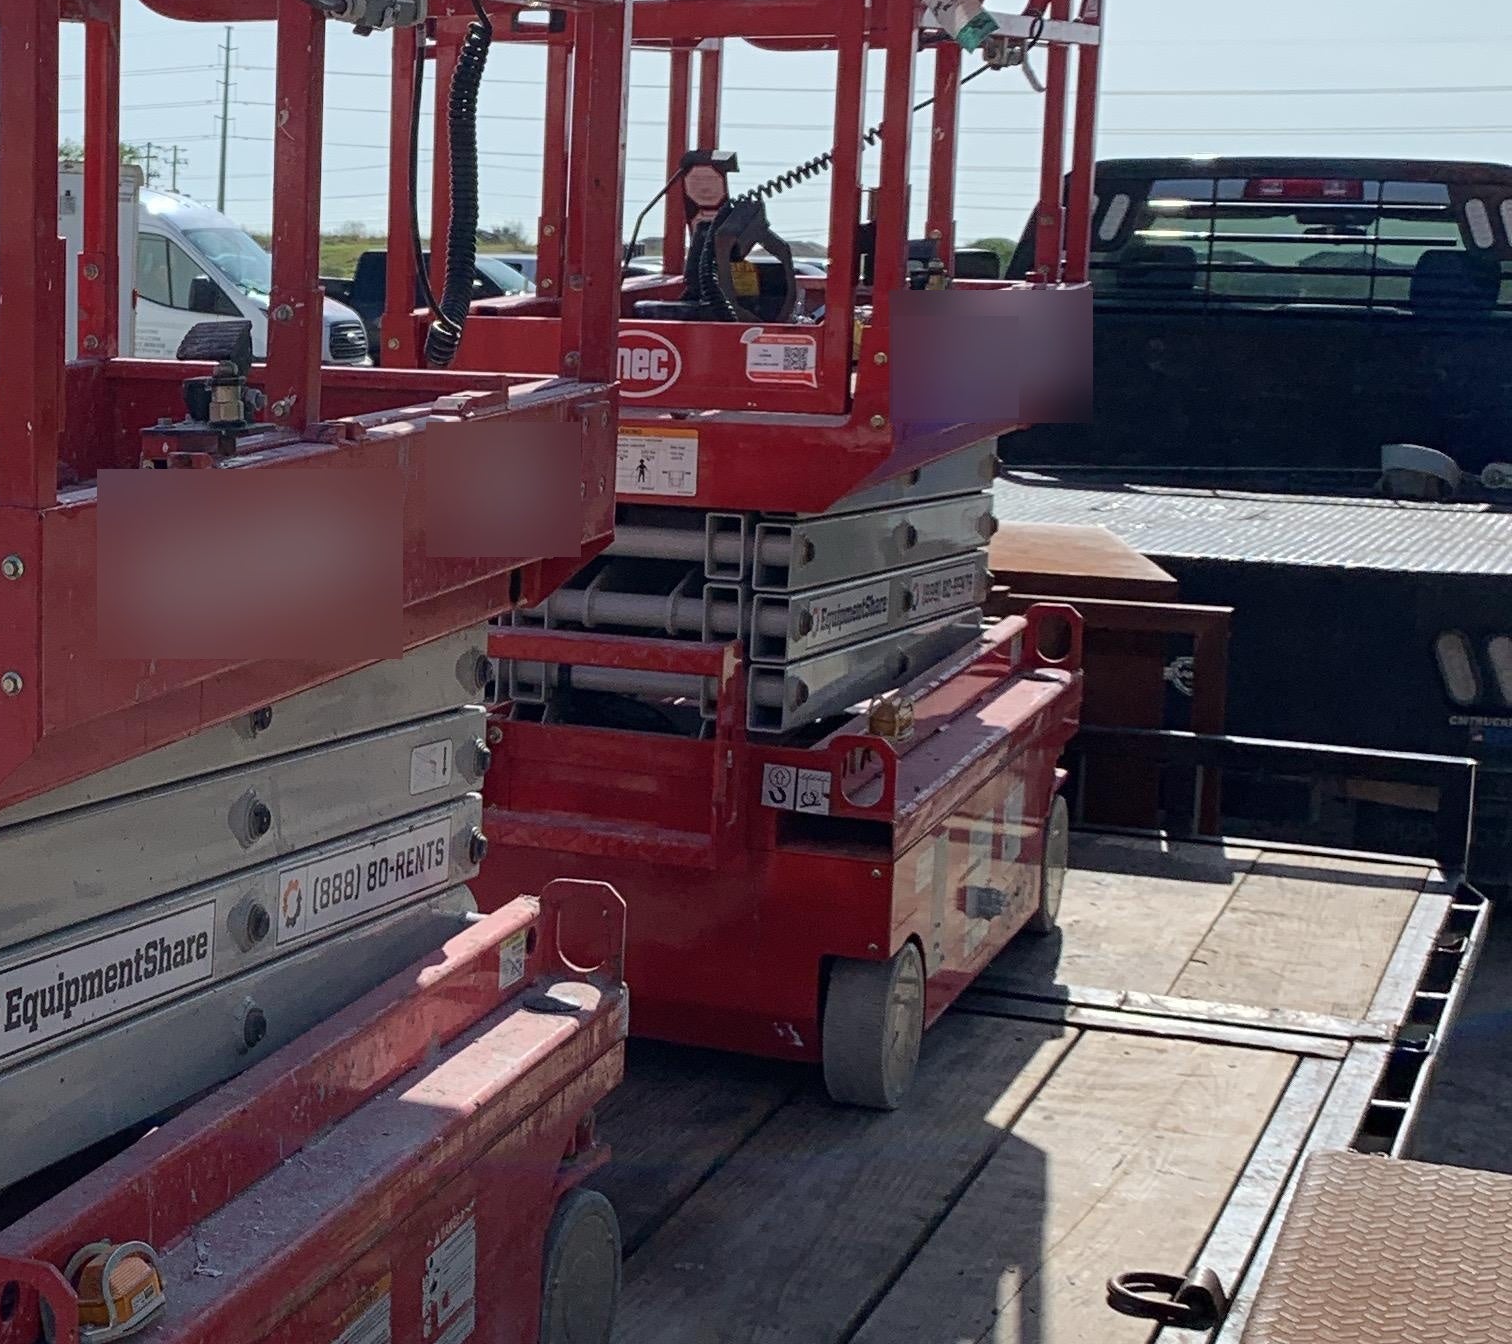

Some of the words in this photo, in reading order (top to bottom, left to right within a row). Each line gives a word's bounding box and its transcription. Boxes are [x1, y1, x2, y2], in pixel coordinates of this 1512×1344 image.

[312, 863, 361, 914] (888)
[367, 837, 445, 893] 80-RENTS
[3, 929, 209, 1033] EquipmentShare
